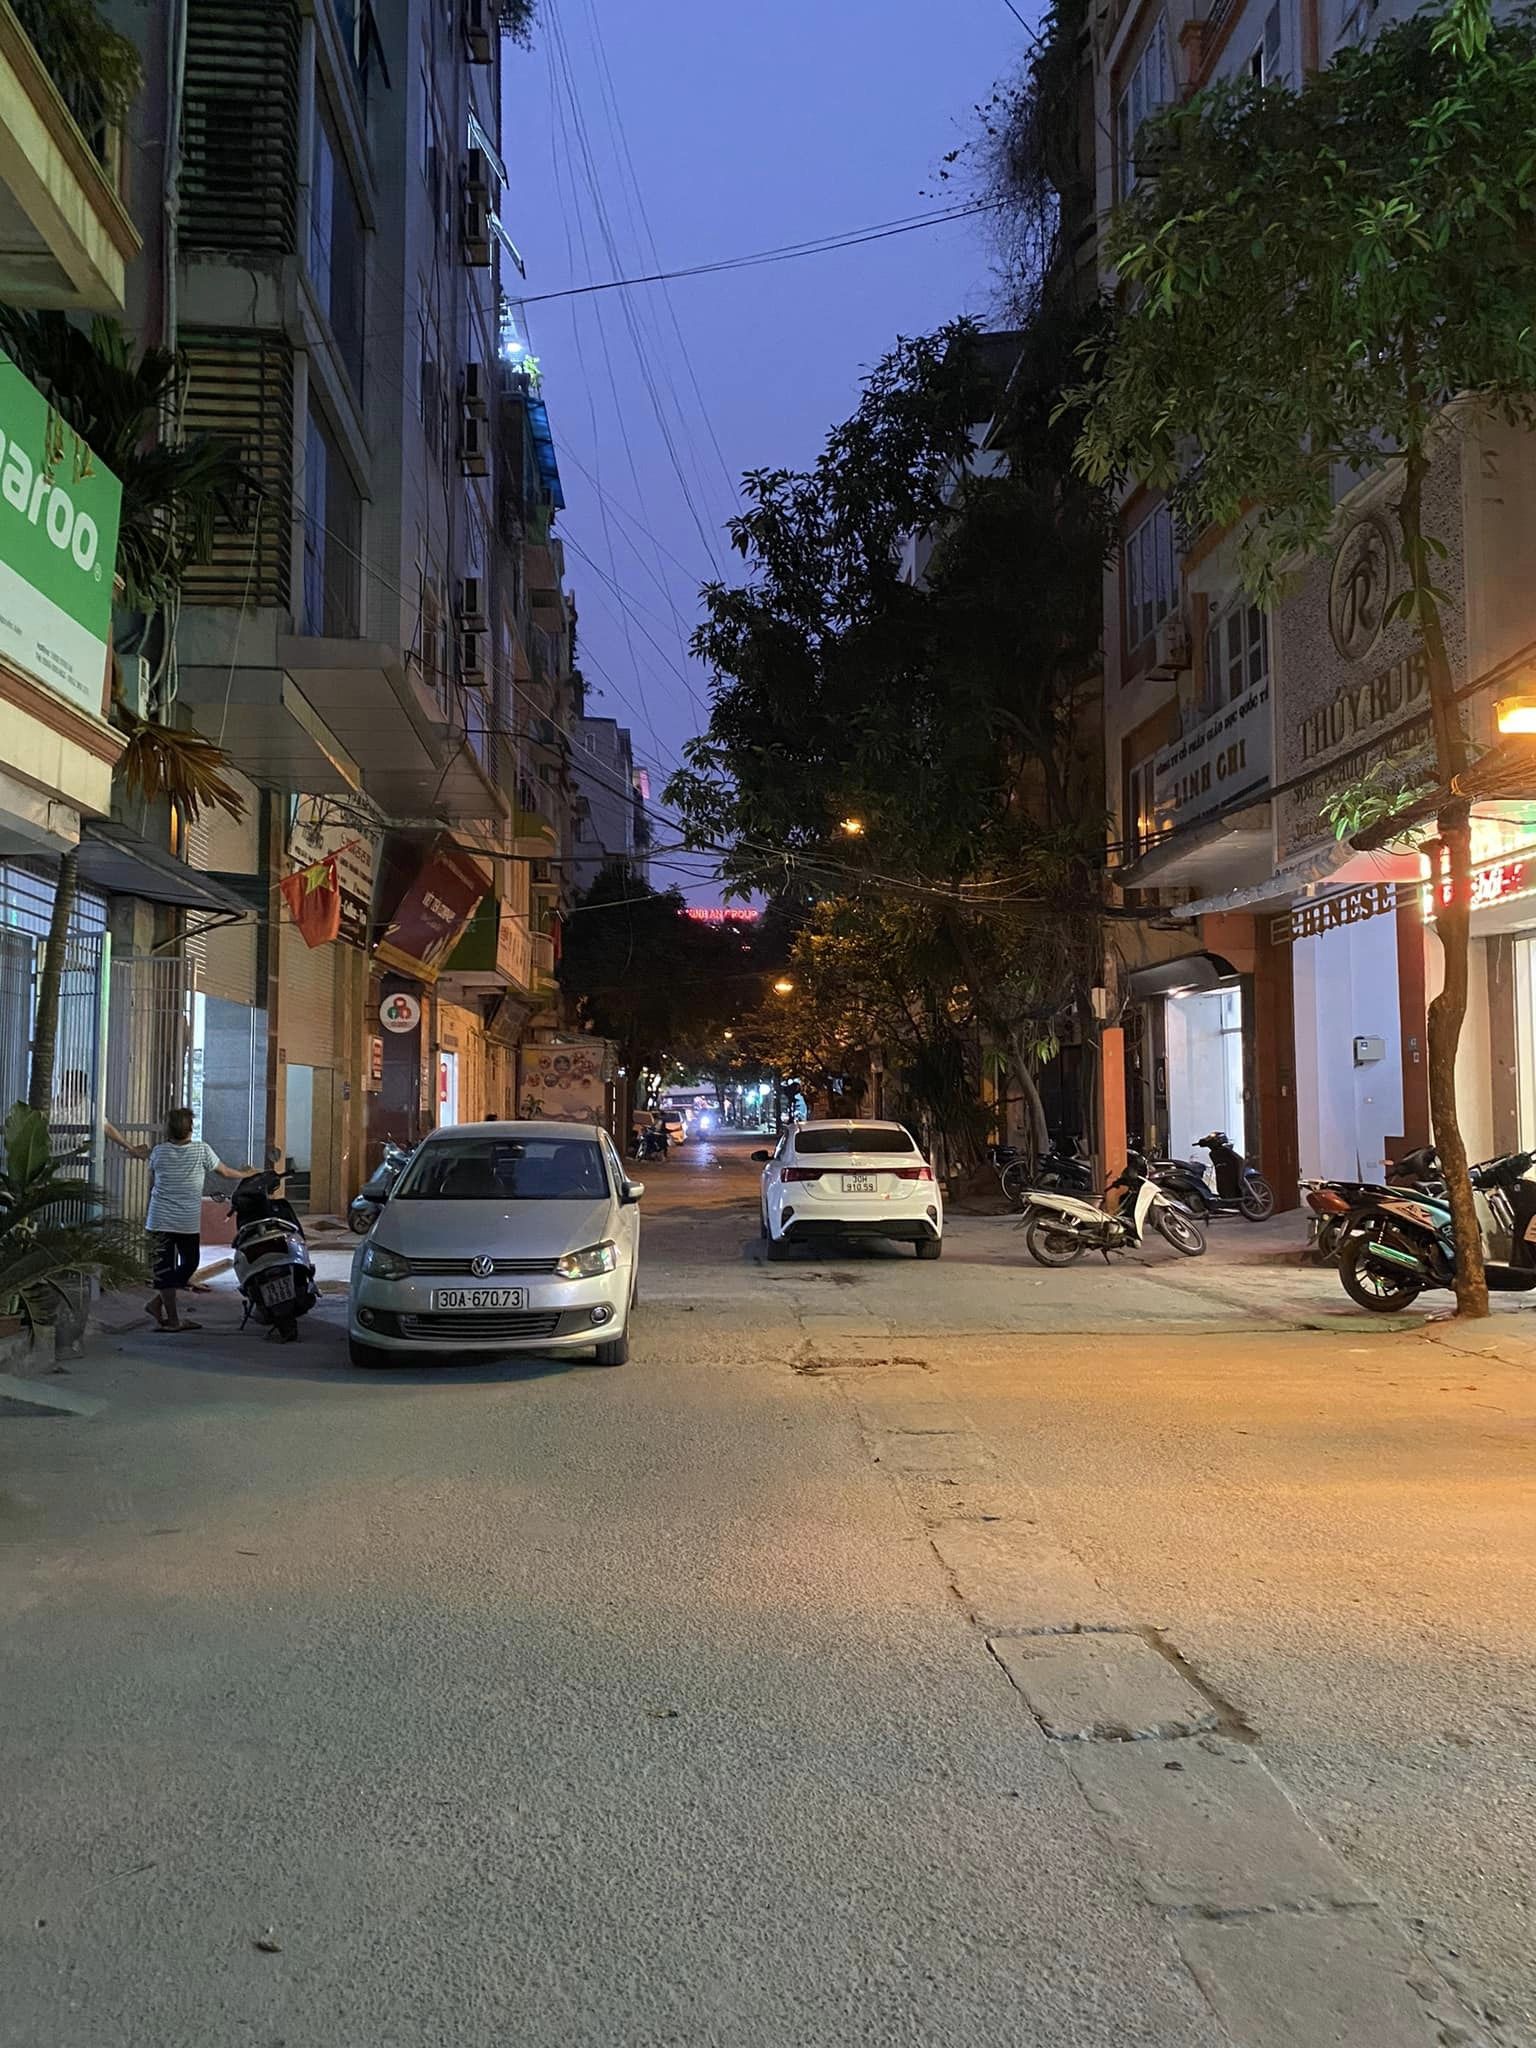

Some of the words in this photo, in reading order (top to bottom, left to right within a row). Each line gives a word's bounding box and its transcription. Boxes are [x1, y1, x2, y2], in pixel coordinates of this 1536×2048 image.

[1174, 761, 1212, 810] LINH
[1216, 739, 1247, 781] CHI
[1290, 882, 1397, 941] CHINESE
[440, 1290, 521, 1307] 30A-670.73
